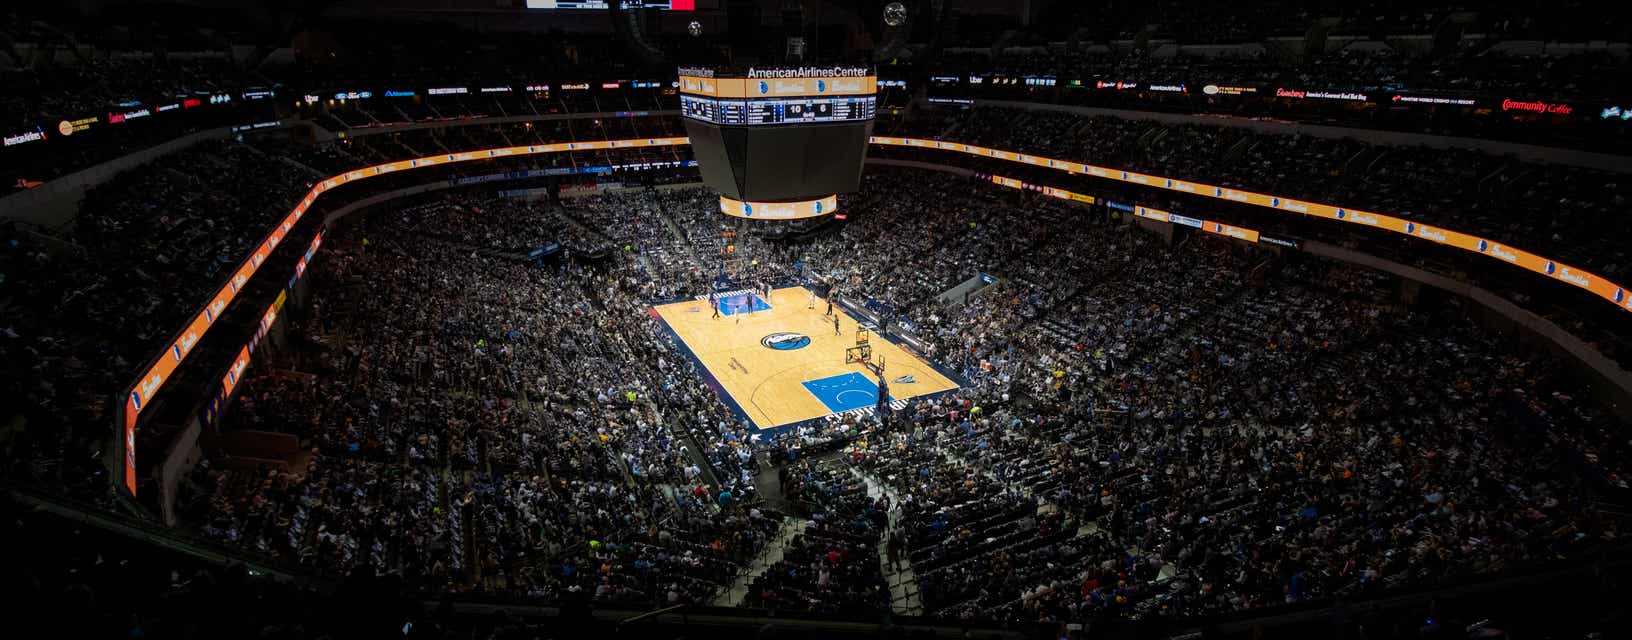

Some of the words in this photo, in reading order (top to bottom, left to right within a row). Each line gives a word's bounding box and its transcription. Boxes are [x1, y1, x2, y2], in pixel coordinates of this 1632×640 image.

[748, 66, 868, 79] AmericanAirlinesCenter
[790, 105, 801, 114] 10
[1502, 98, 1547, 113] Community
[1548, 103, 1572, 114] Coffee
